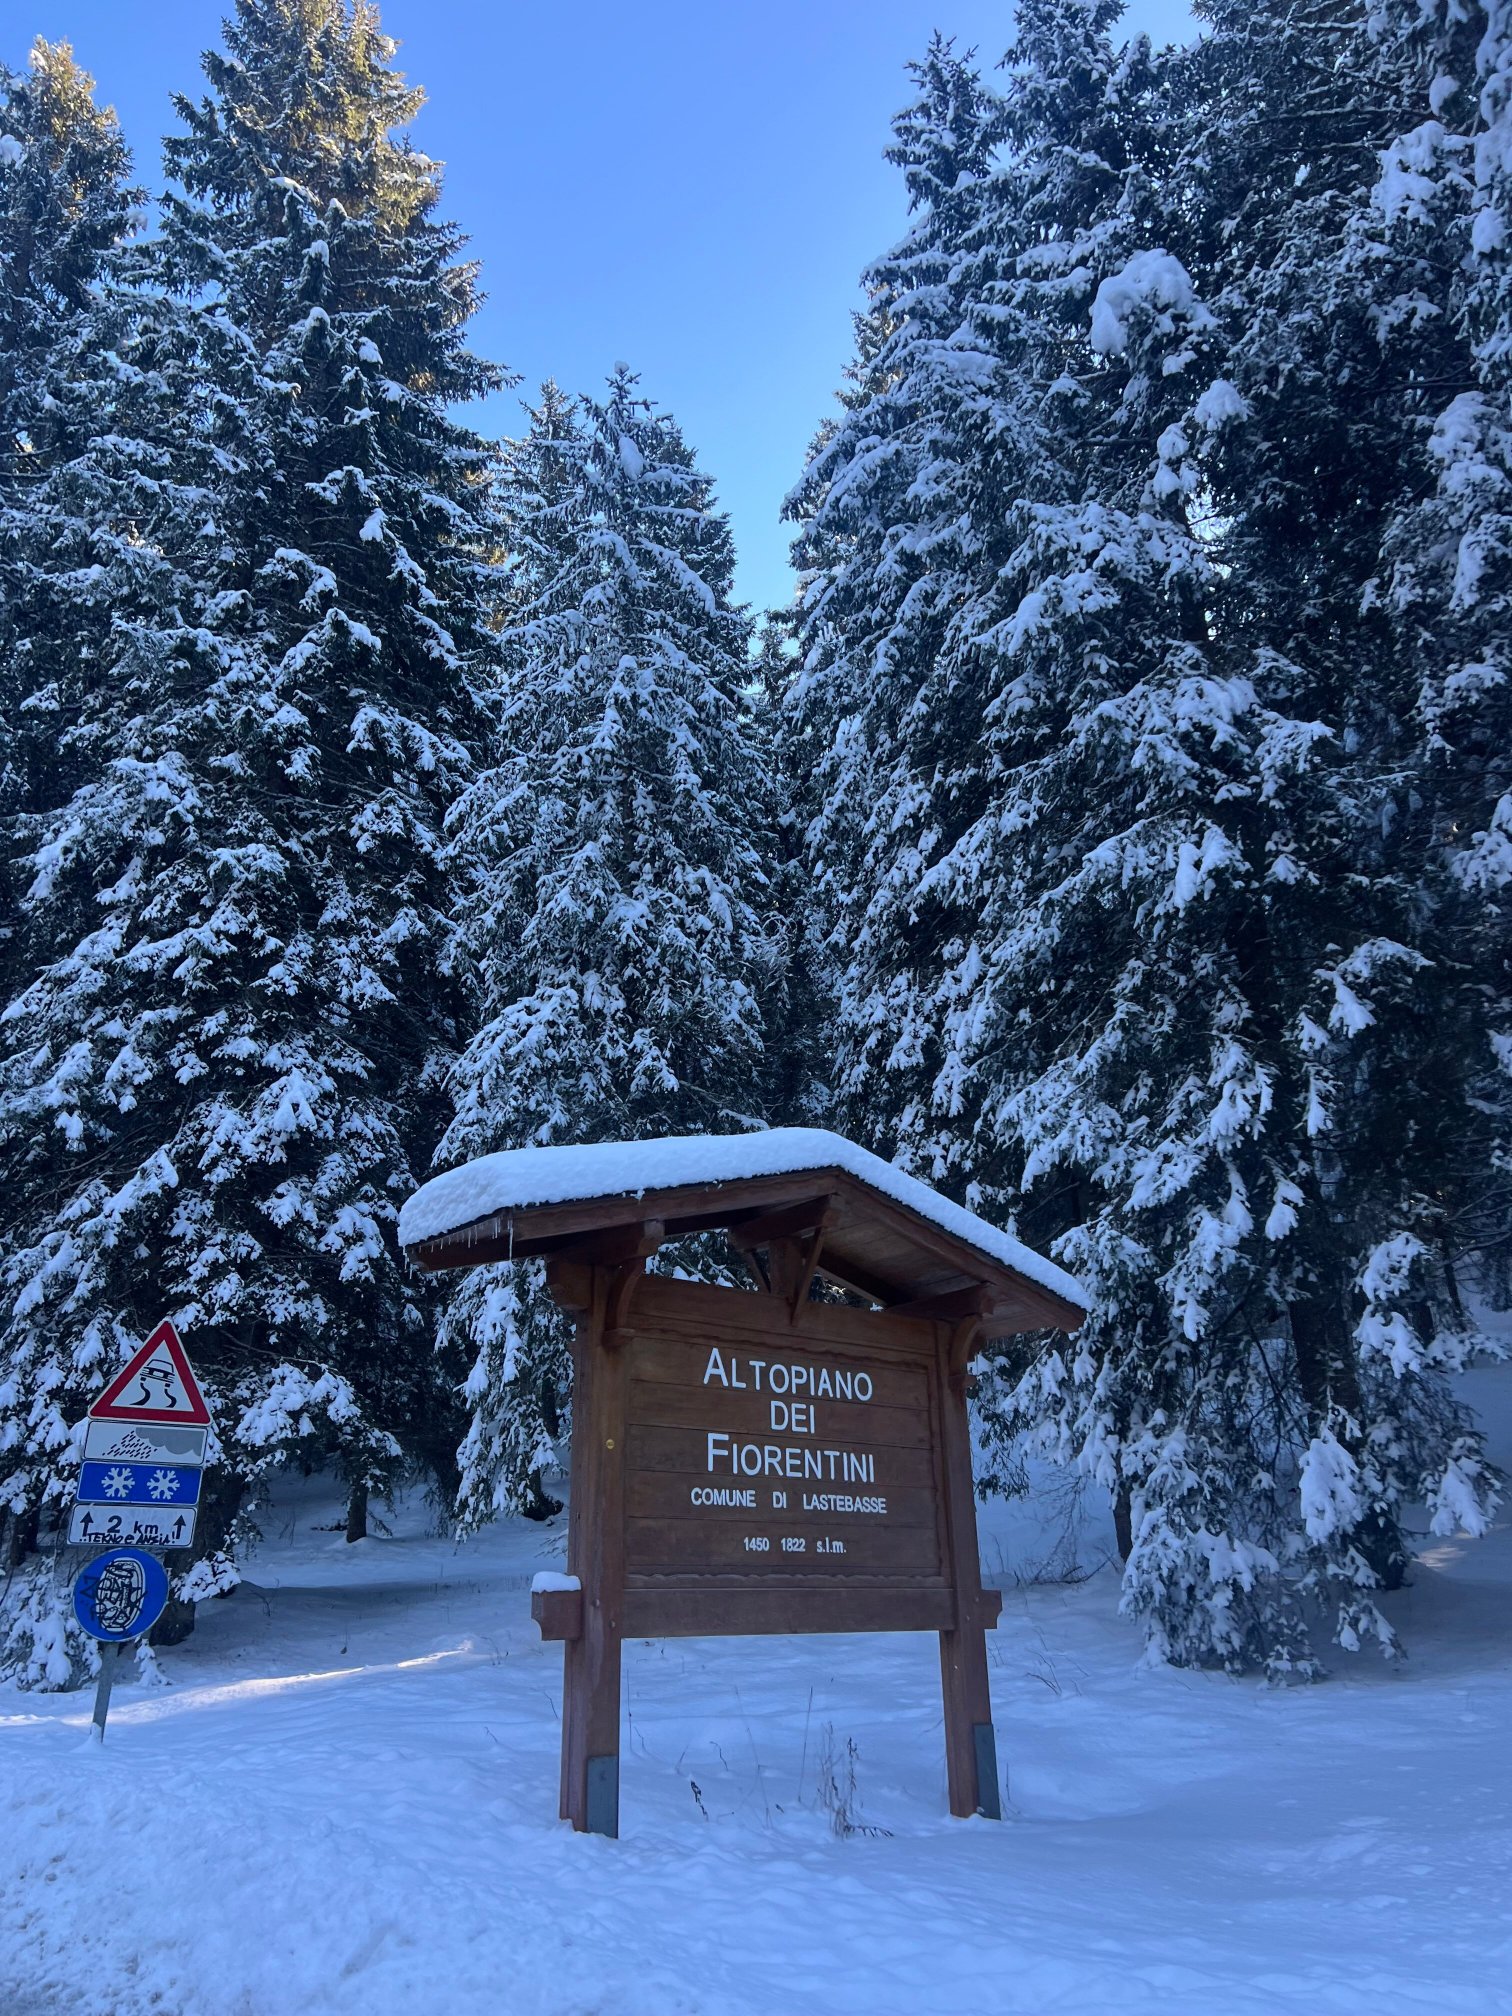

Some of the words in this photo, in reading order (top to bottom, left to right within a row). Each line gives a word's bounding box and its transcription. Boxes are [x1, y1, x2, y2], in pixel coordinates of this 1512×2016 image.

[703, 1347, 873, 1402] ALTOPIANO
[770, 1400, 815, 1434] DEI
[706, 1432, 875, 1483] FIORENTINI
[690, 1487, 757, 1508] COMUNE
[772, 1491, 787, 1509] DI
[803, 1493, 887, 1514] LASTEBASSE
[107, 1515, 122, 1534] 2
[133, 1520, 159, 1535] km
[743, 1537, 770, 1552] 1450
[780, 1537, 806, 1552] 1822
[816, 1536, 847, 1553] s.l.m.
